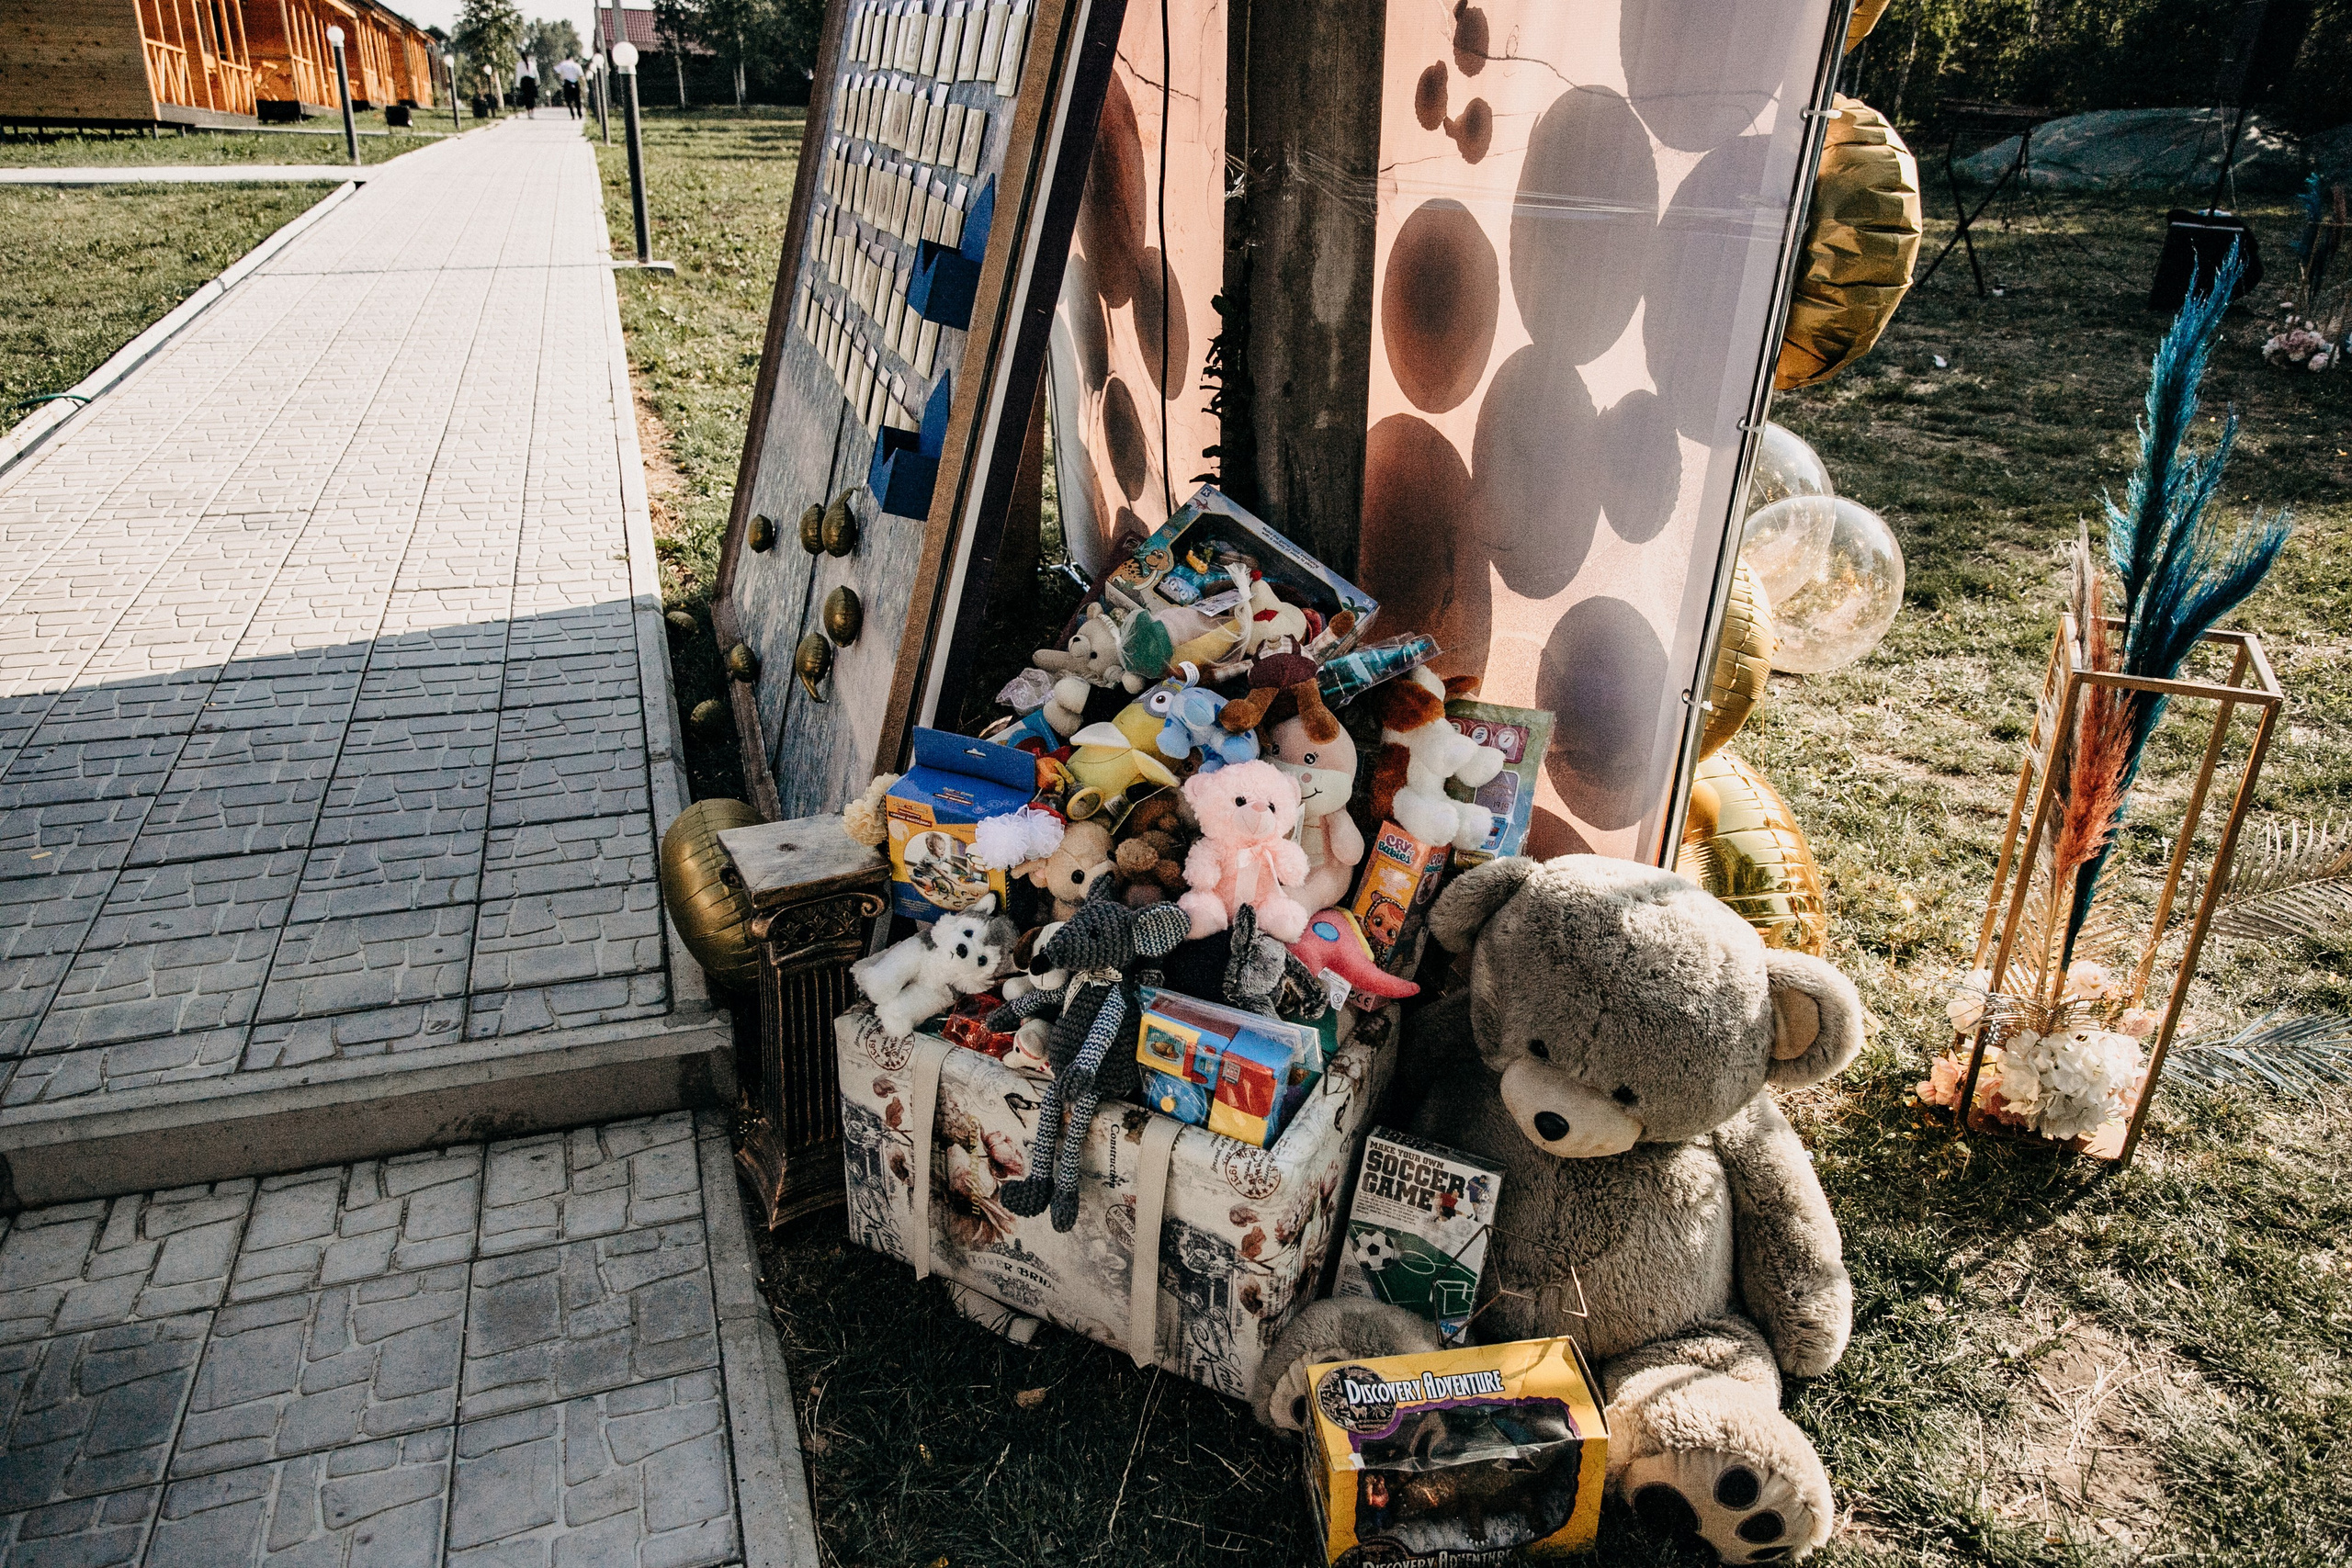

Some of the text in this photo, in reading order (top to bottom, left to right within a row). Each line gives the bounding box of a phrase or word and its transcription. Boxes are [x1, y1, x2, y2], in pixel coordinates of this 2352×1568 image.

[1377, 840, 1412, 864] Babies
[1385, 834, 1413, 853] CRY
[1110, 1123, 1120, 1189] Construction
[1369, 1140, 1445, 1169] MAKE YOUR OWN
[1361, 1171, 1436, 1212] GAME
[1365, 1149, 1466, 1199] SOCCER
[1343, 1370, 1505, 1405] DISCOVERY ADVENTURE
